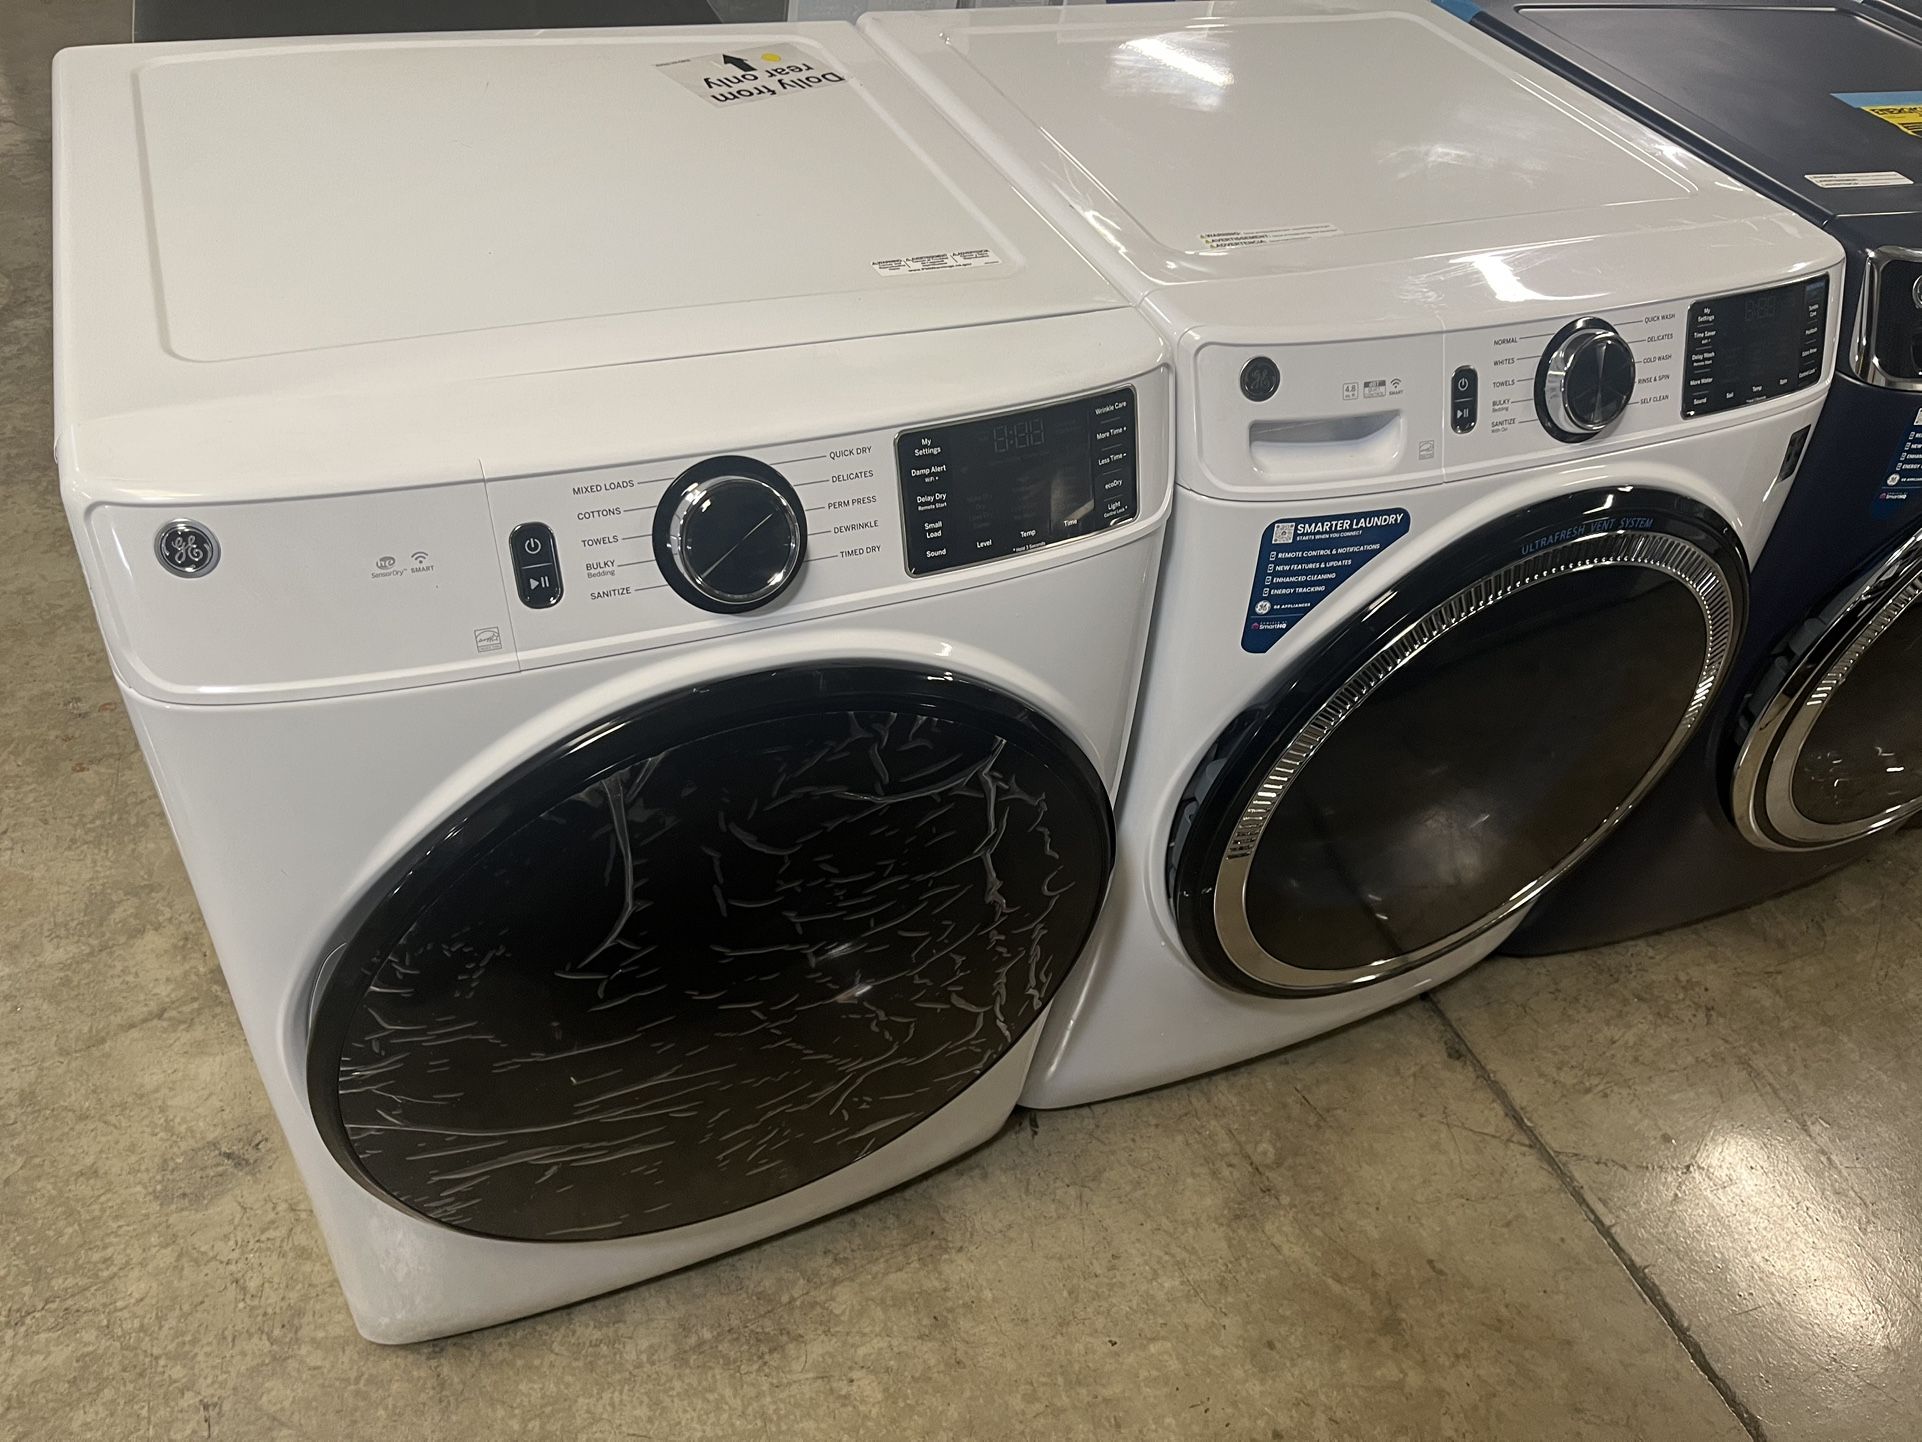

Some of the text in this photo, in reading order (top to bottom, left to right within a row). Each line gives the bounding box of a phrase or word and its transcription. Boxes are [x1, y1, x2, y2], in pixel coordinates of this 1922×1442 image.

[703, 62, 816, 89] rear only
[710, 71, 846, 103] Dolly from
[1644, 316, 1660, 324] QUICK
[1698, 315, 1715, 323] Settings
[1493, 337, 1518, 346] NORMAL
[1647, 333, 1673, 343] DELICATES
[1493, 358, 1515, 367] WHITES
[1643, 356, 1657, 364] COLD
[1493, 380, 1515, 389] TOWELS
[1638, 377, 1653, 385] RINSE
[1658, 374, 1670, 382] SPIN
[1492, 399, 1511, 407] BULKY
[1640, 394, 1669, 405] SELF CLEAN
[1693, 397, 1707, 405] Sound
[1095, 400, 1127, 415] Wrinkle Care
[1491, 418, 1516, 428] SANITIZE
[1096, 431, 1111, 441] More
[1110, 427, 1123, 436] Time
[921, 438, 932, 447] My
[829, 445, 872, 460] QUICK DRY
[914, 446, 941, 457] Settings
[1098, 456, 1111, 466] Less
[1110, 452, 1123, 462] Time
[831, 469, 874, 483] DELICATES
[911, 464, 947, 477] Damp Alert
[572, 479, 635, 496] MIXED LOADS
[1104, 479, 1123, 490] ecoDry
[827, 495, 877, 510] PERM PRESS
[916, 492, 947, 503] Delay Dry
[918, 501, 947, 512] Remote Start
[1107, 500, 1121, 511] Light
[576, 507, 621, 521] COTTONS
[833, 519, 879, 534] DEWRINKLE
[924, 520, 943, 530] Small
[1063, 519, 1078, 527] Time
[1297, 513, 1404, 534] SMARTER LAUNDRY
[926, 530, 942, 539] Load
[1020, 529, 1037, 538] Temp
[1339, 530, 1363, 538] CONNECT
[1521, 517, 1655, 555] ULTRAFRESH VENT SYSTEM
[581, 535, 619, 548] TOWELS
[976, 539, 993, 549] Level
[840, 544, 881, 558] TIMED DRY
[926, 548, 947, 558] Sound
[1278, 551, 1302, 559] REMOTE
[1303, 549, 1331, 557] CONTROL
[1337, 543, 1381, 554] NOTIFICATIONS
[410, 565, 435, 574] SMART
[586, 560, 615, 571] BULKY
[1290, 561, 1320, 570] FEATURES
[1326, 559, 1352, 567] UPDATES
[587, 569, 616, 579] Bedding
[1273, 572, 1337, 583] ENHANCED CLEANING
[590, 586, 632, 600] SANITIZE
[1270, 585, 1326, 595] ENERGY TRACKING
